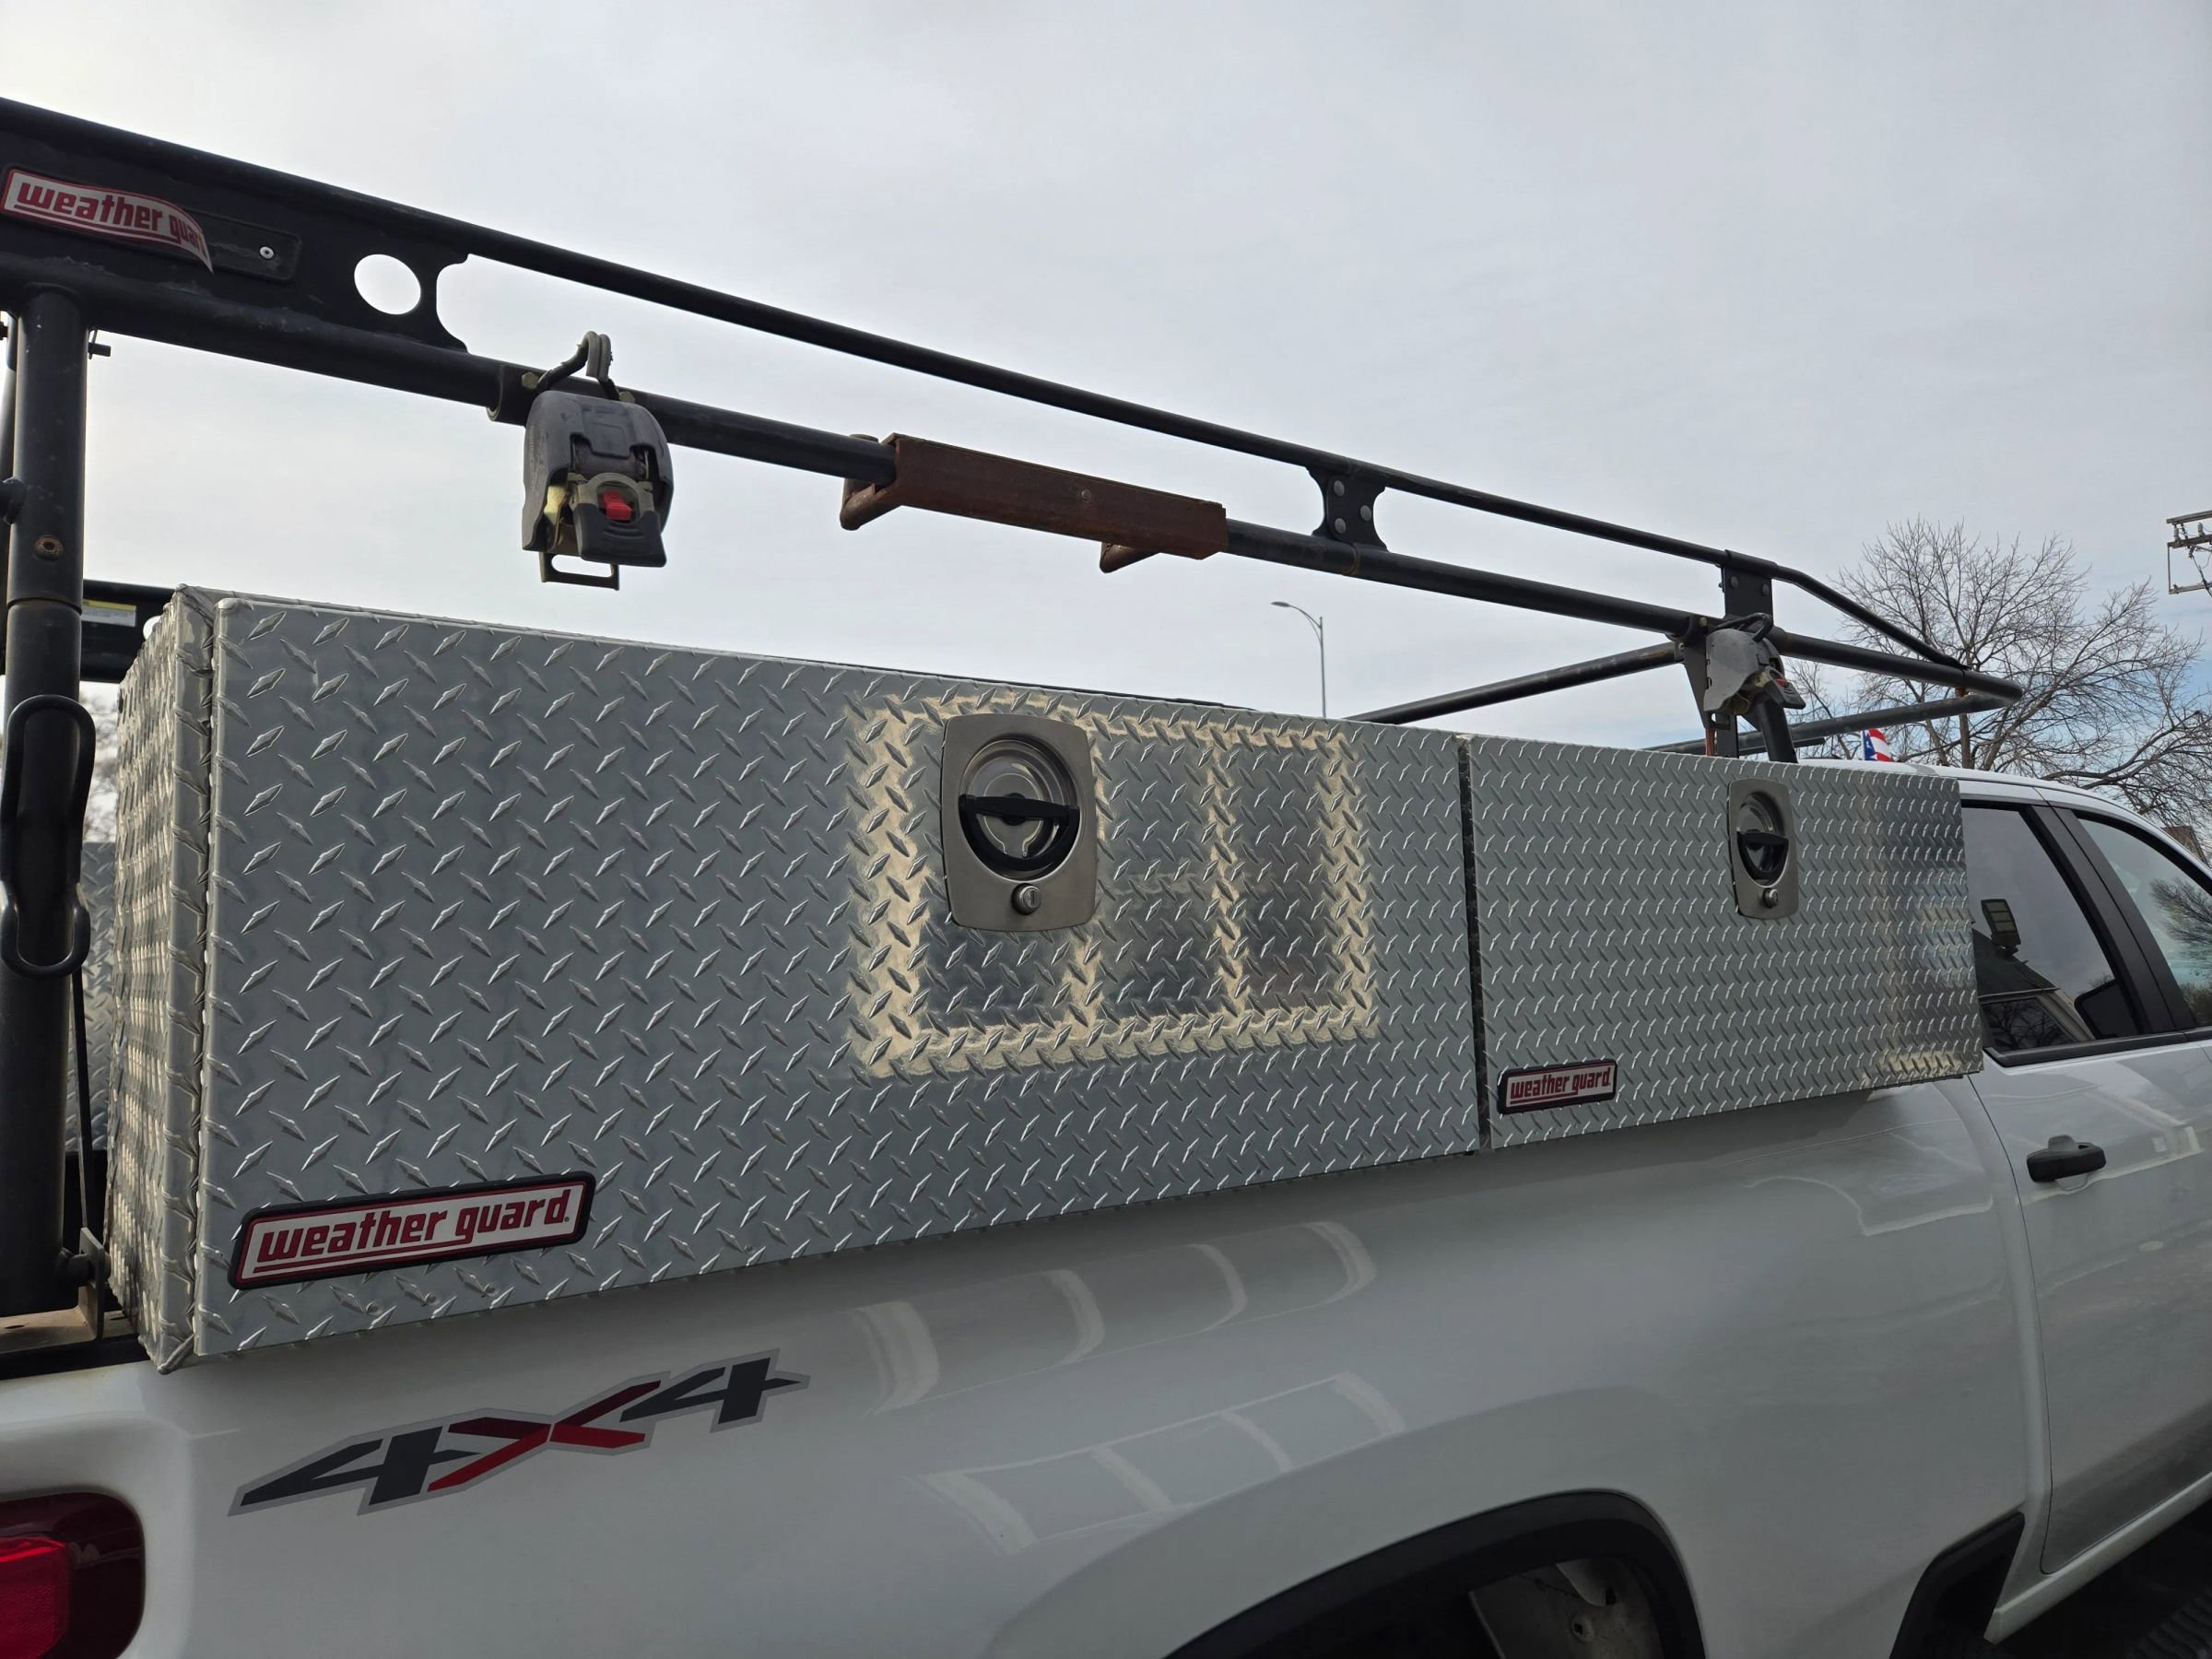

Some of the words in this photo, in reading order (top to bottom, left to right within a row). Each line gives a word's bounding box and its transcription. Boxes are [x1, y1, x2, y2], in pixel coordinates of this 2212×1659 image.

[17, 182, 163, 231] weather
[1510, 1073, 1570, 1100] weather
[1571, 1066, 1611, 1095] guard
[256, 1209, 448, 1264] weather
[455, 1189, 572, 1245] guard
